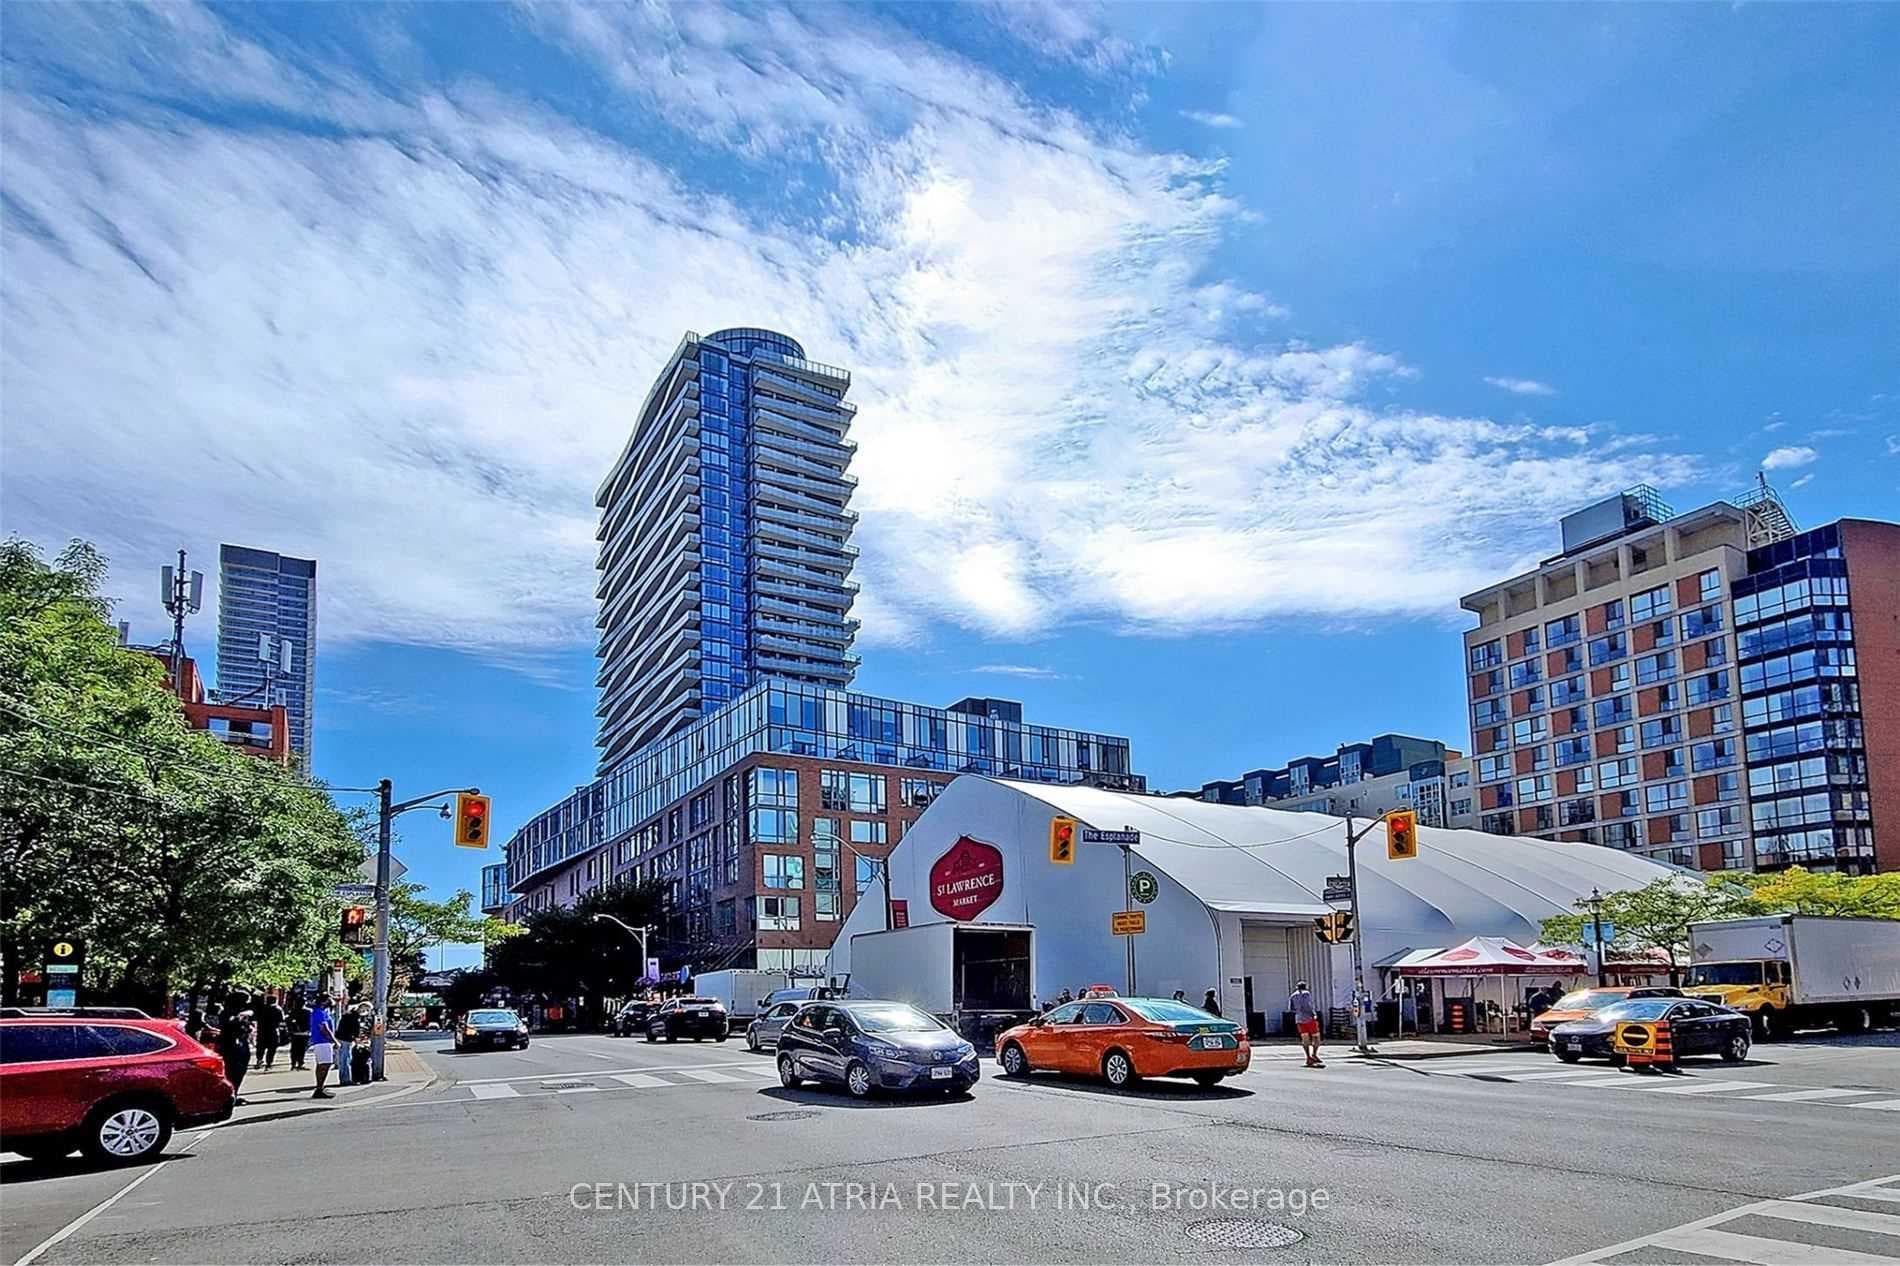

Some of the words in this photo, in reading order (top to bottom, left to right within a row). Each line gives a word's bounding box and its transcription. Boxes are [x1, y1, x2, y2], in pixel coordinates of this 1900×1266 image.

[1084, 830, 1099, 841] The
[1100, 831, 1139, 843] Esplanade
[946, 873, 995, 895] LAWRENCE
[1139, 879, 1151, 893] P
[952, 894, 978, 907] MARKET
